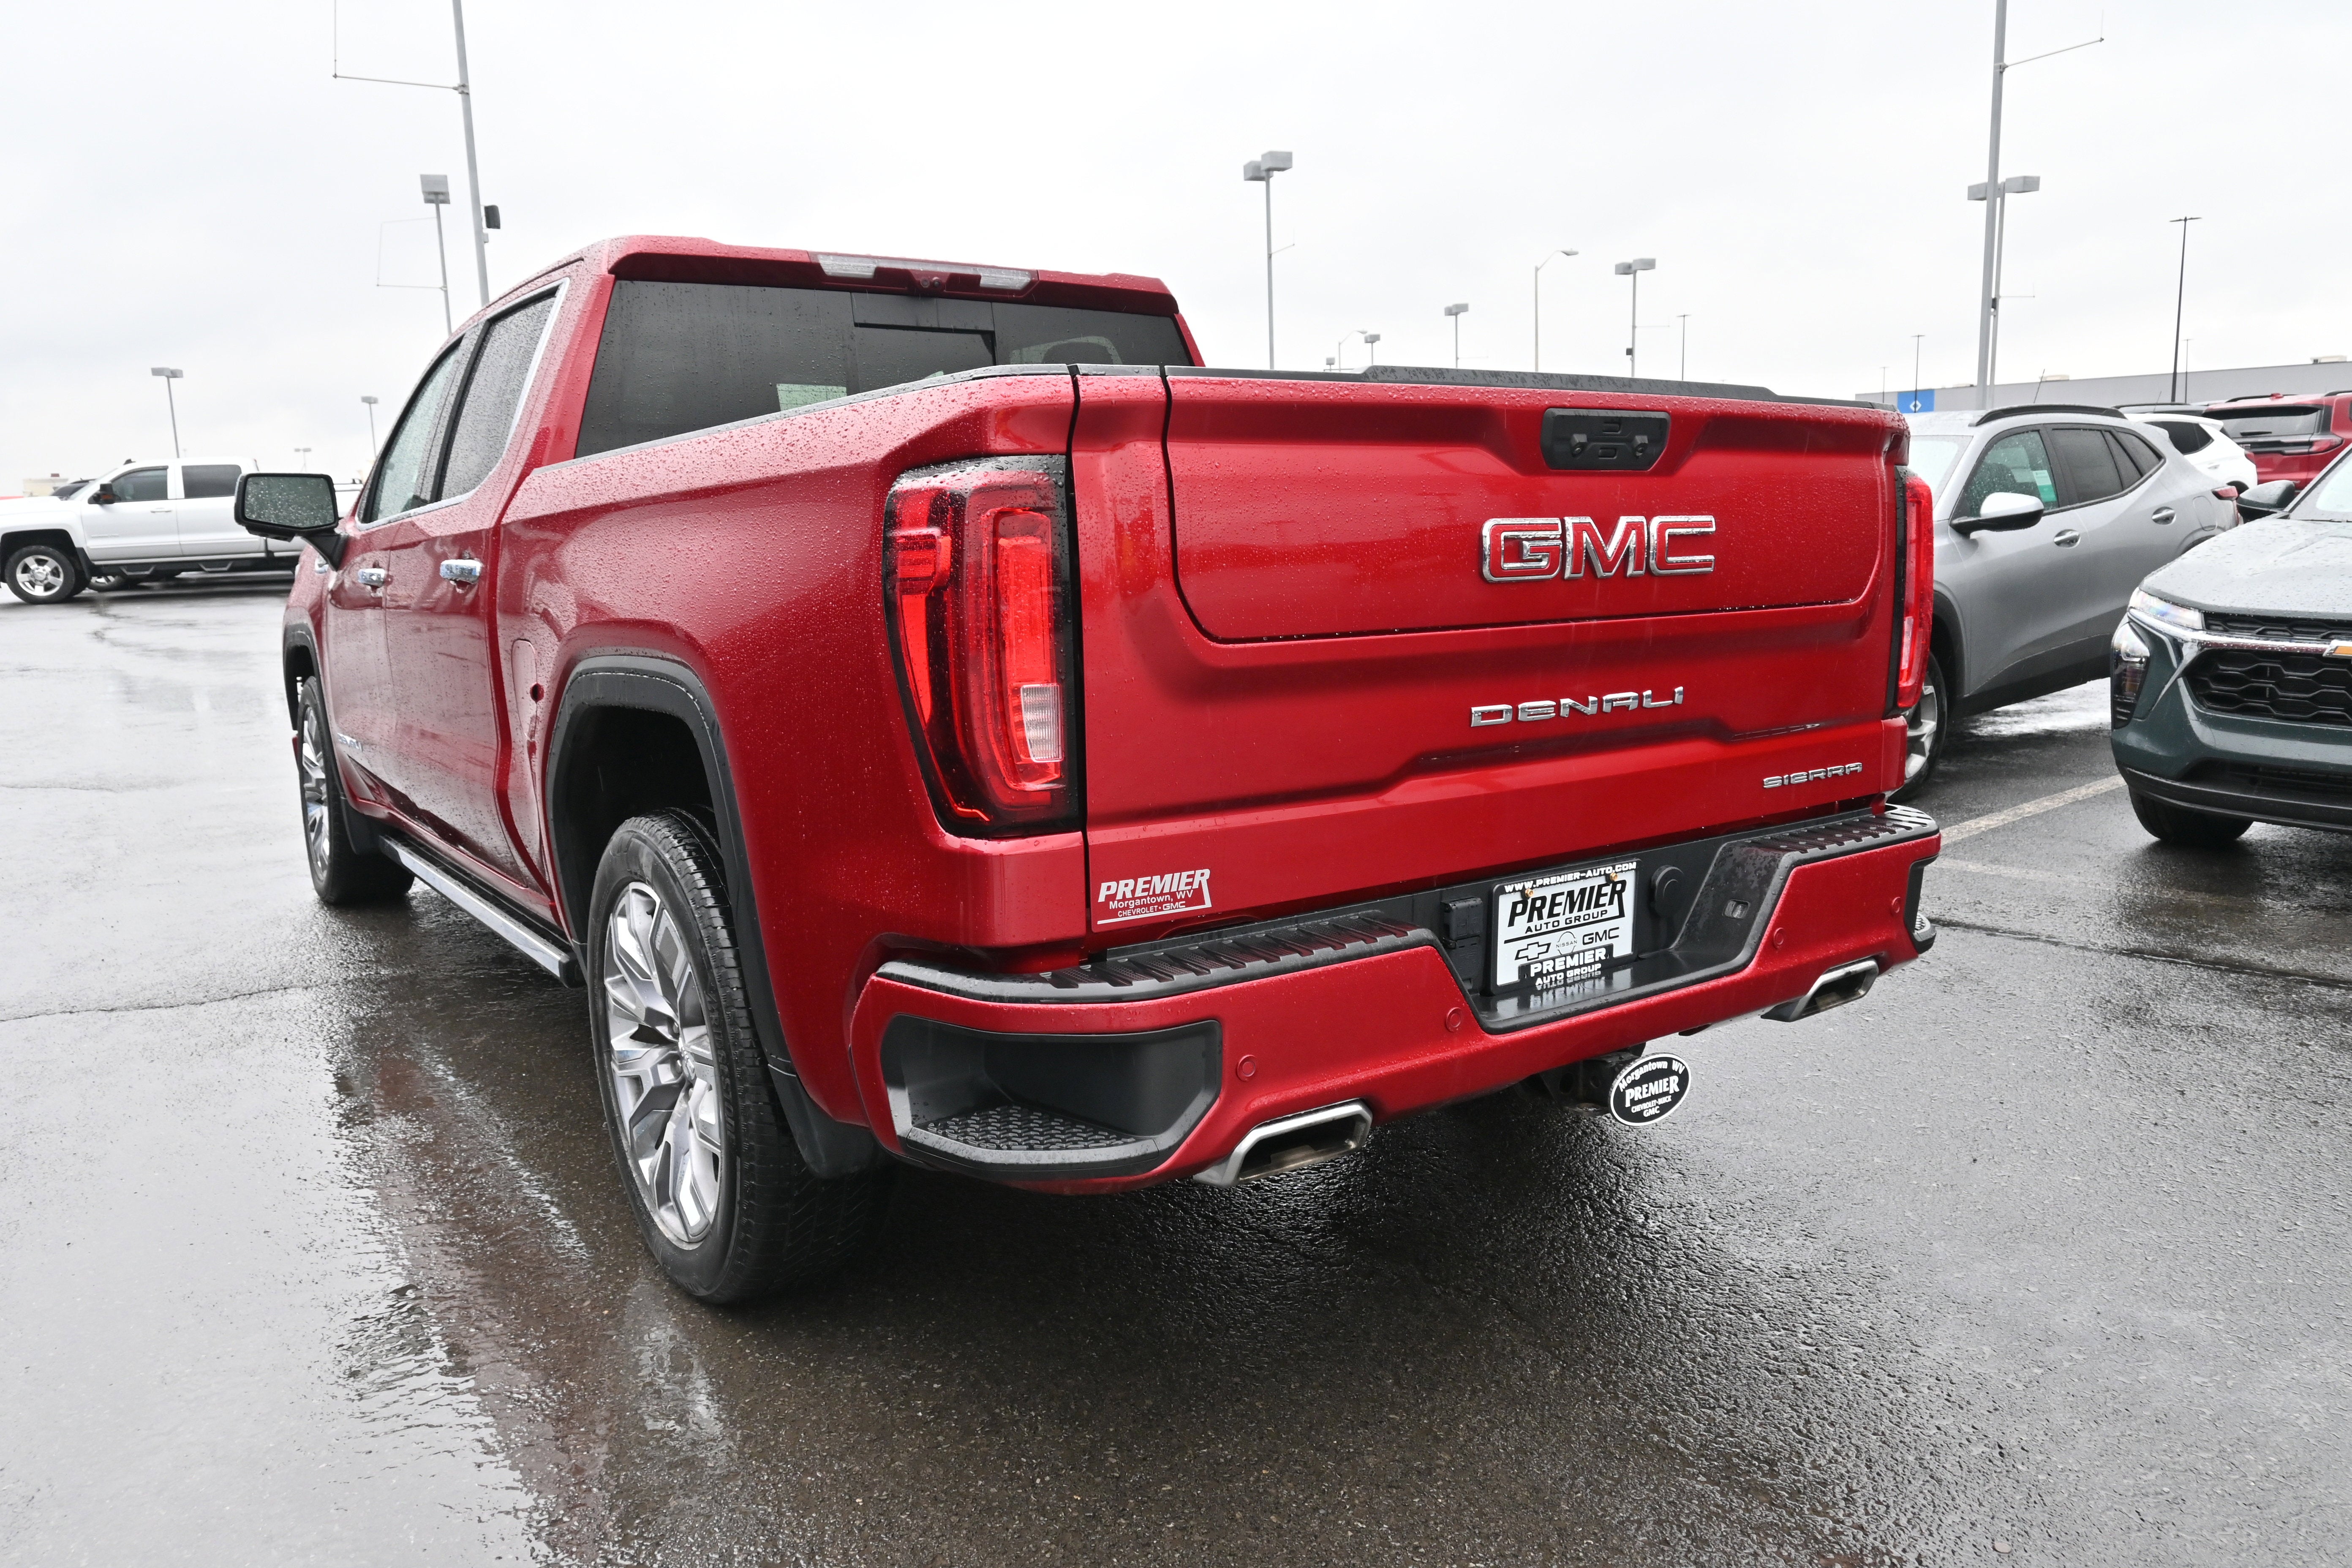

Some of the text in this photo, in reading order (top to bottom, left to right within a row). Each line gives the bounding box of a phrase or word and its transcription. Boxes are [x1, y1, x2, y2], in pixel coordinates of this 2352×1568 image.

[1481, 515, 1716, 583] GMC
[1470, 686, 1684, 727] DENALI
[1763, 762, 1863, 789] SIERRA
[1098, 868, 1211, 903] PREMIER
[1504, 861, 1637, 893] WWW.PREMIER-AUTO.COM
[1109, 889, 1193, 910] Morgantown, WV
[1117, 901, 1186, 917] CHEVROLET GMC
[1508, 879, 1627, 928] PREMIER
[1525, 909, 1608, 934] AUTO GROUP
[1556, 939, 1578, 948] NISSAN
[1582, 926, 1620, 946] GMC
[1530, 947, 1606, 977] PREMIER
[1535, 963, 1602, 986] AUTO GROUP
[1618, 1059, 1685, 1092] Morgantown WV
[1625, 1075, 1680, 1108] PREMIER
[1643, 1106, 1660, 1117] GMC
